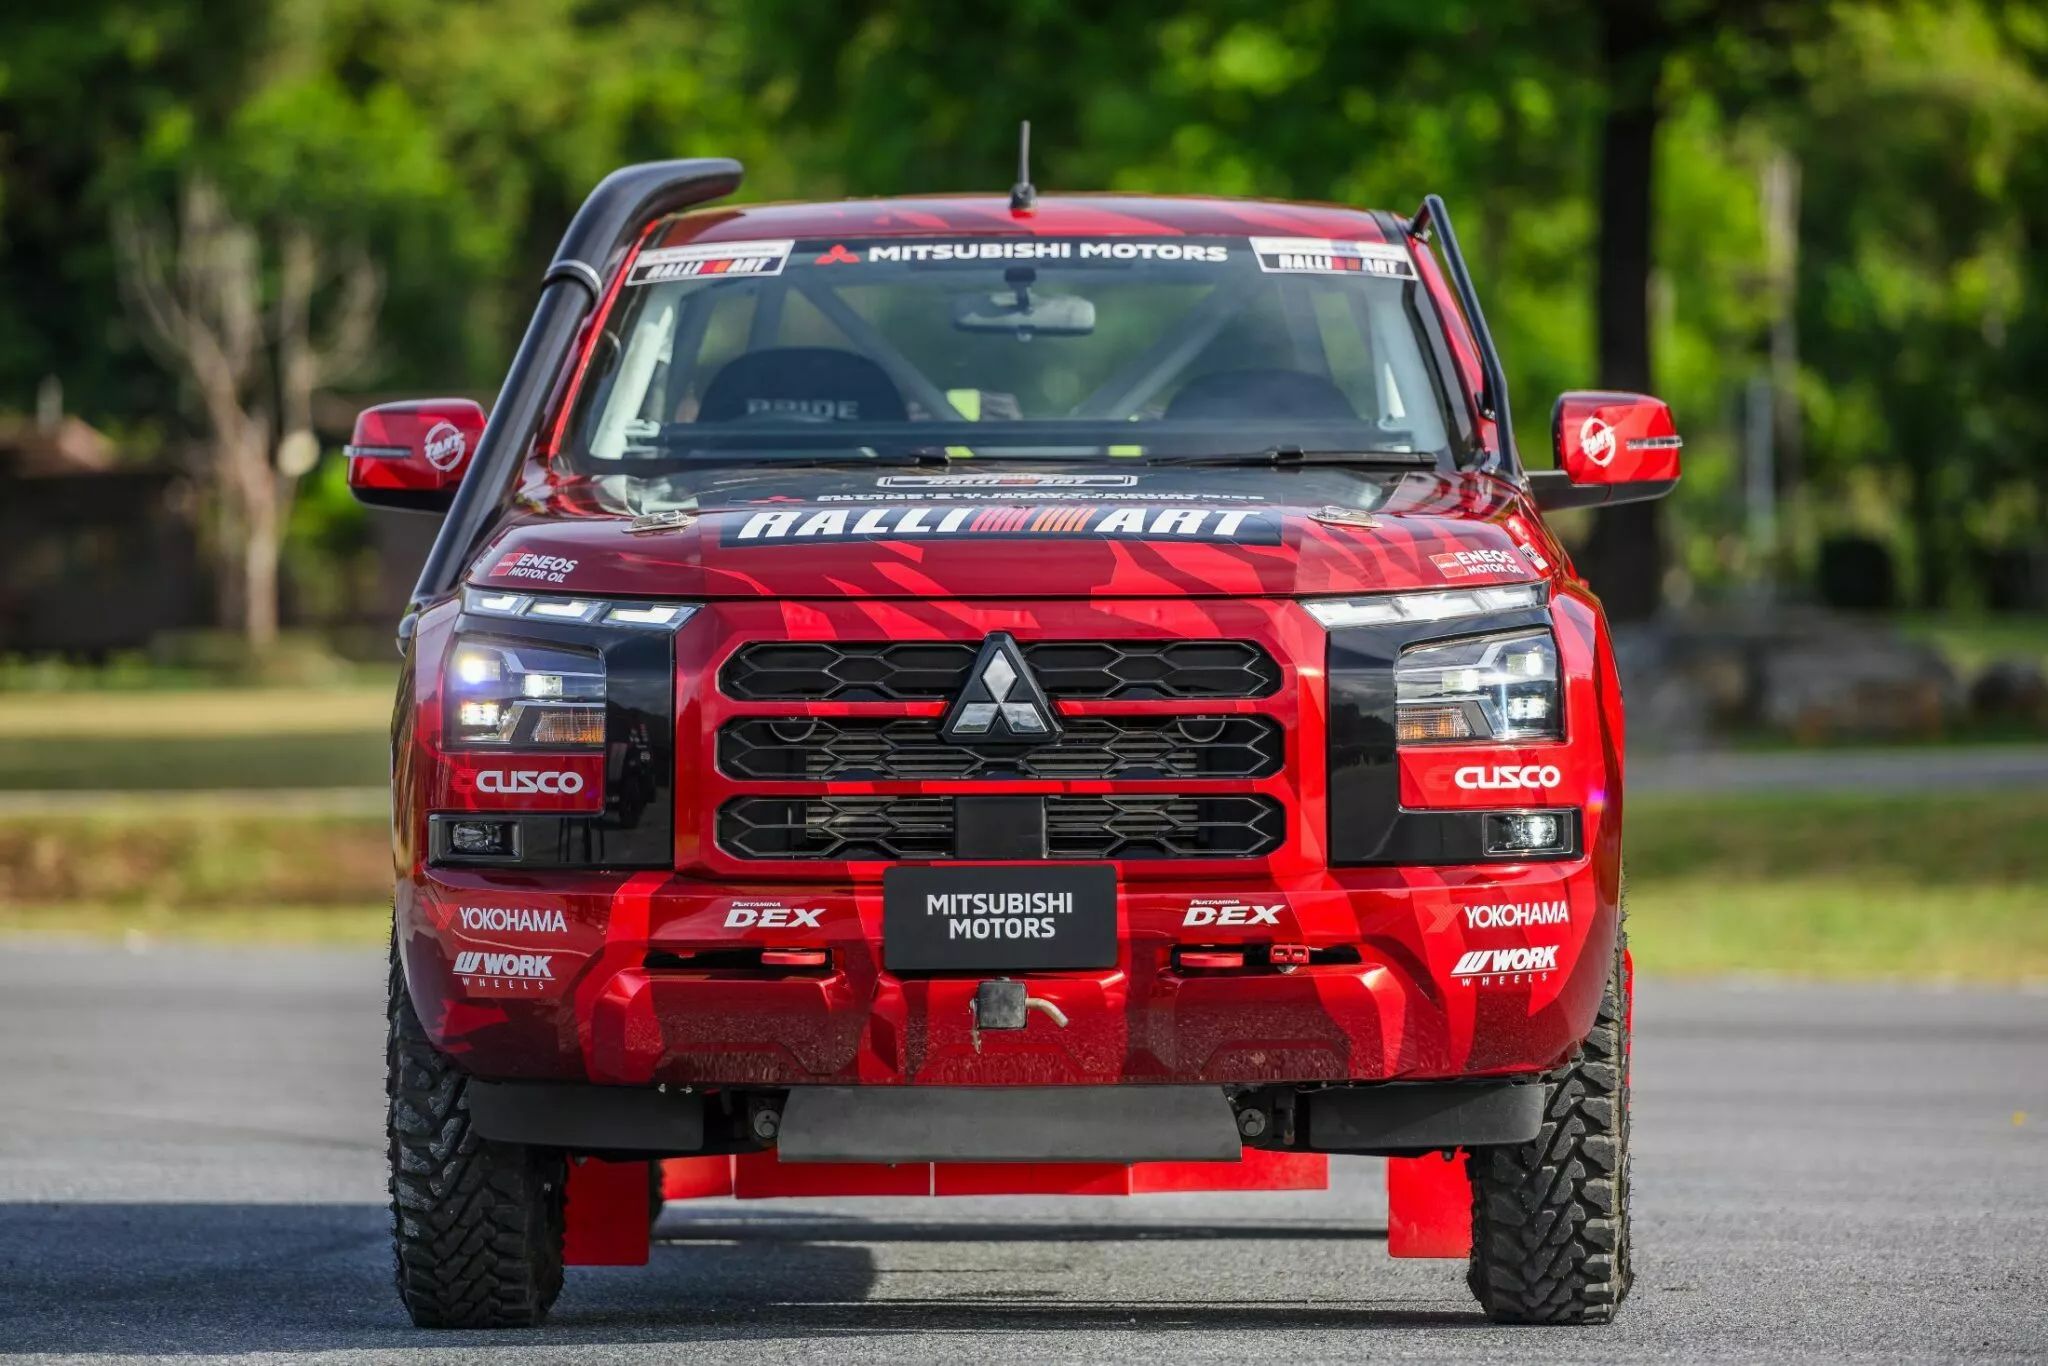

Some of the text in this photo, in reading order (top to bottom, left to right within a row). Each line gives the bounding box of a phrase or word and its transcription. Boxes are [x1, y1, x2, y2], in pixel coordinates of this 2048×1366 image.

[868, 242, 1229, 263] MITSUBISHI MOTORS
[516, 553, 578, 573] ENEOS
[1454, 549, 1517, 565] ENEOS
[508, 567, 566, 583] MOTOR OIL
[1466, 563, 1507, 575] MOTOR
[1507, 564, 1525, 575] OIL
[476, 771, 583, 794] CUSCO
[1454, 765, 1561, 789] CUSCO
[926, 892, 1073, 916] MITSUBISHI
[1182, 904, 1286, 927] DEX
[1464, 900, 1569, 929] YOKOHAMA
[459, 907, 568, 933] YOKOHAMA
[723, 908, 827, 928] DEX
[949, 917, 1056, 940] MOTORS
[482, 952, 552, 977] WORK
[1491, 944, 1559, 973] WORK
[462, 977, 544, 990] WHEELS
[1461, 972, 1547, 987] WHEELS
